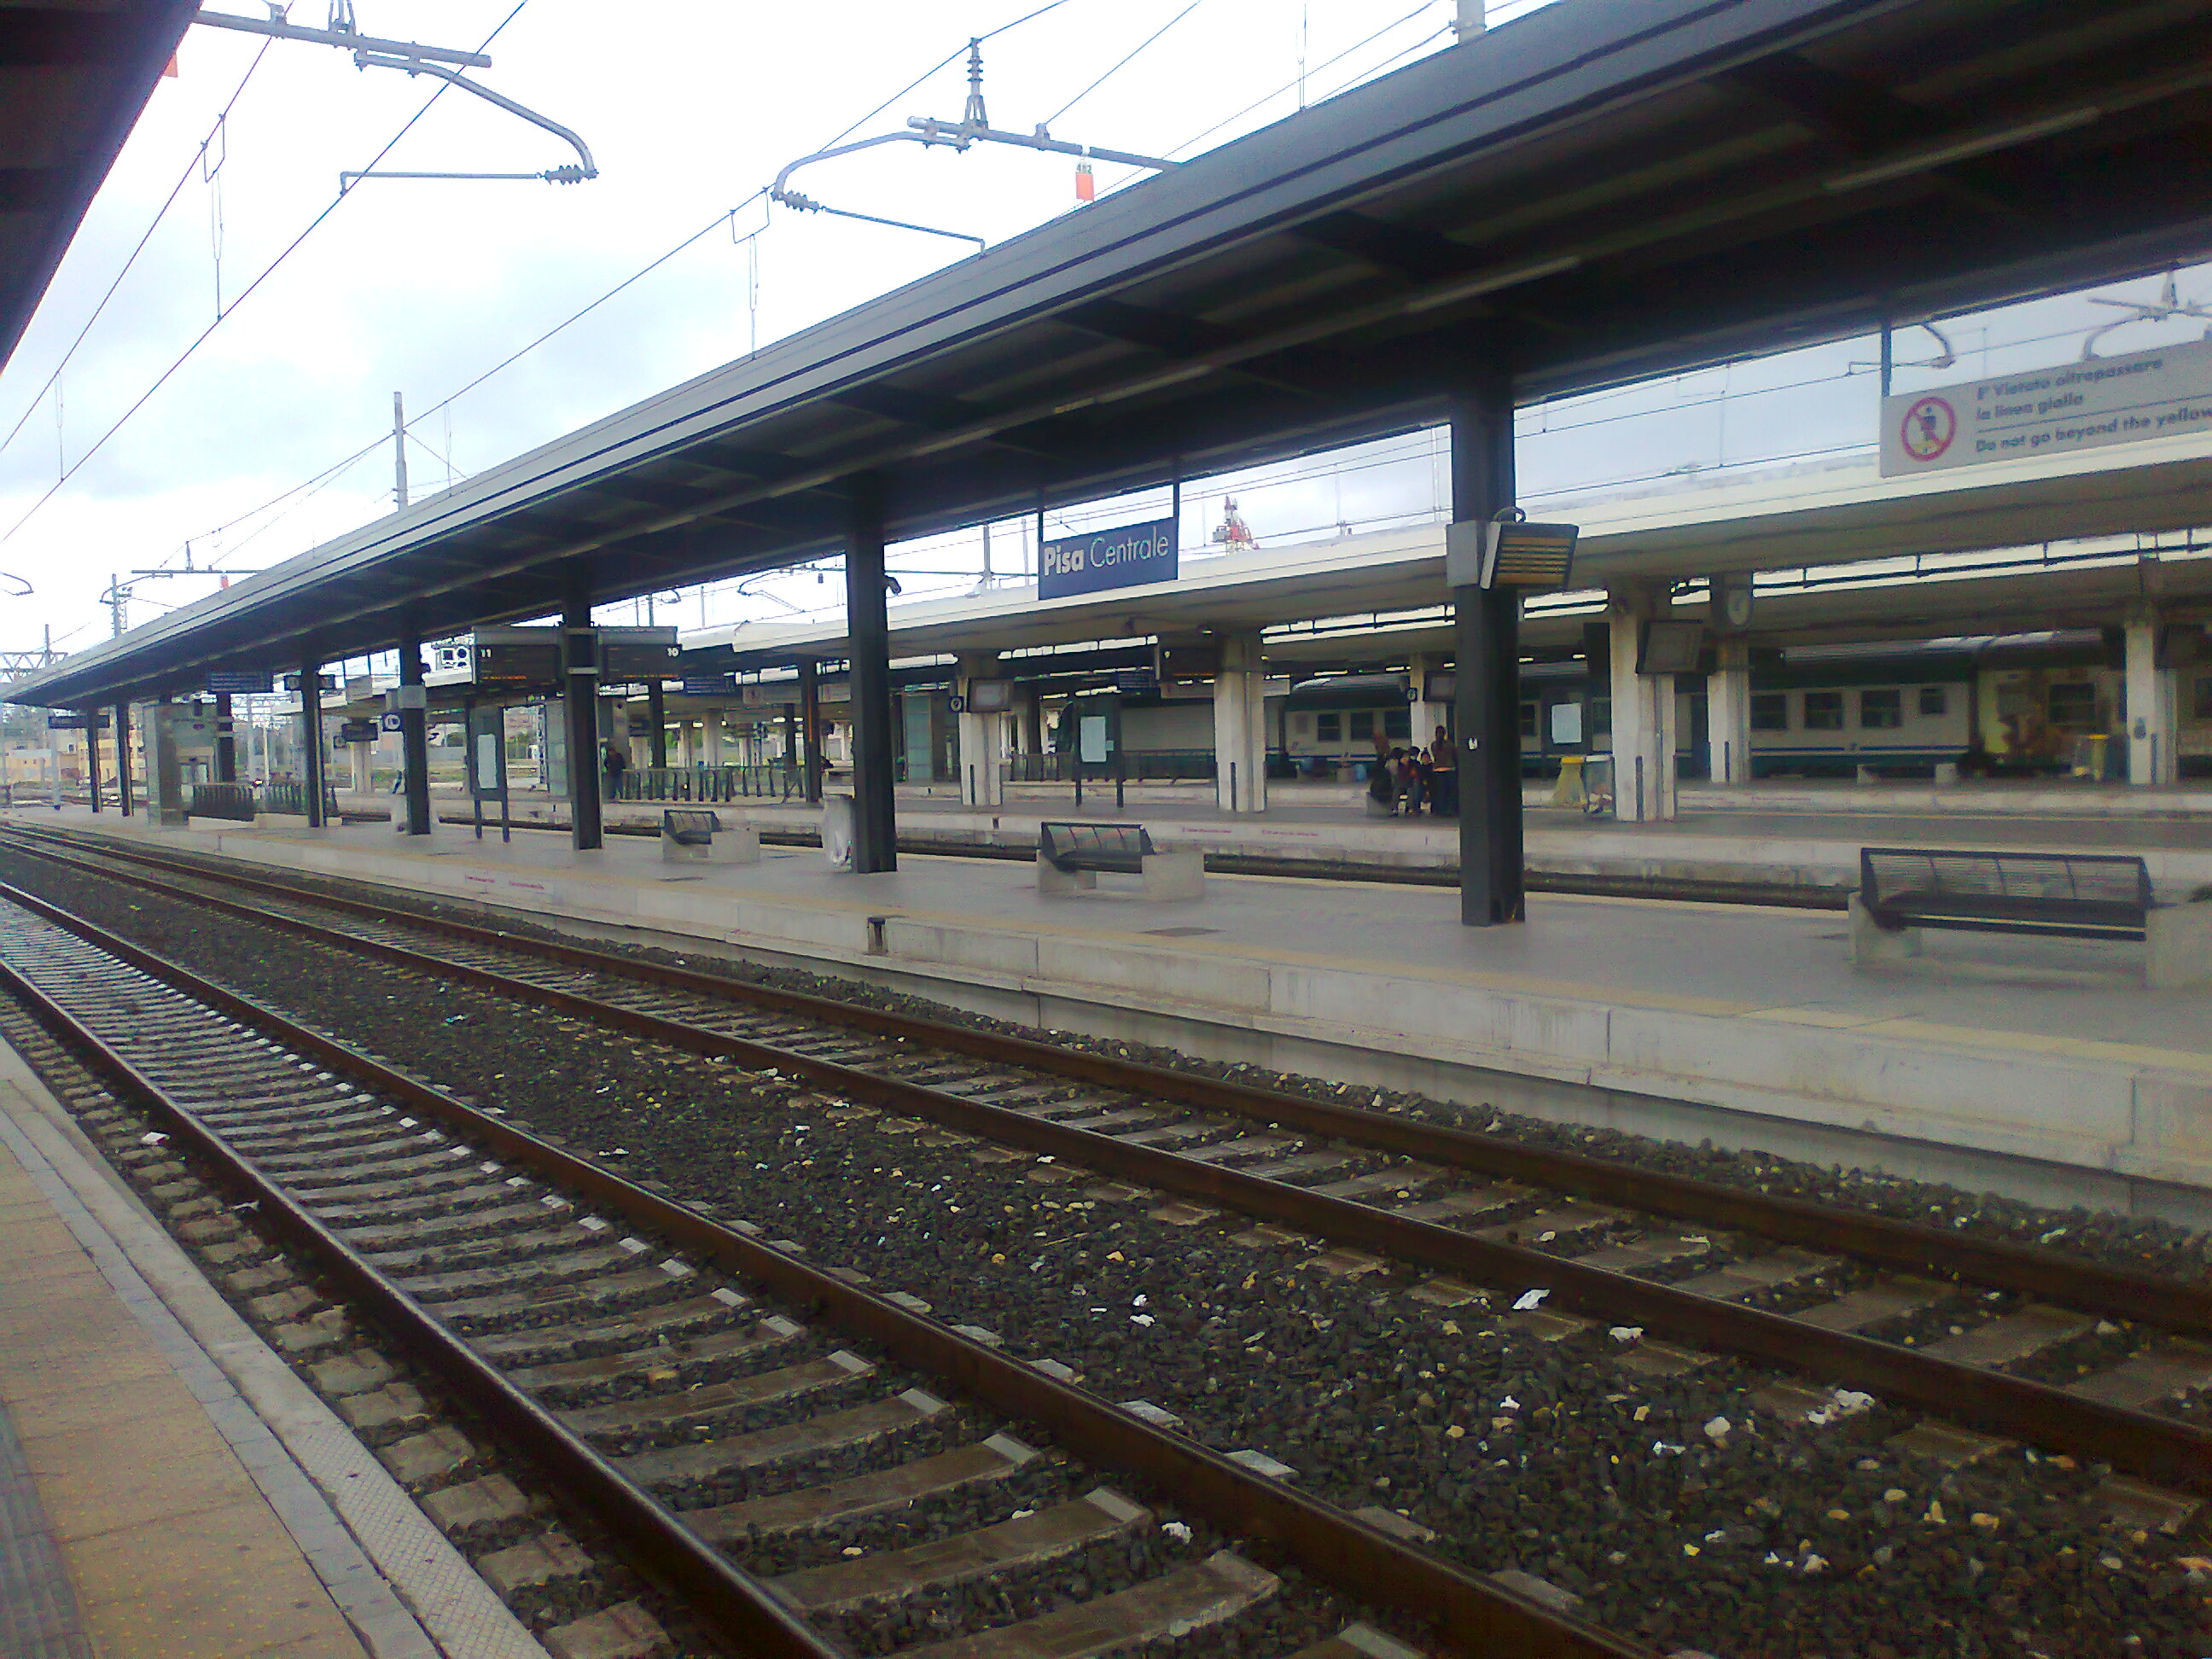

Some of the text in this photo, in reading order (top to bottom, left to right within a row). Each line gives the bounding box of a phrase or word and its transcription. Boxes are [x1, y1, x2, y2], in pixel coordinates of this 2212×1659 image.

[2031, 433, 2051, 448] go
[2054, 419, 2118, 442] beyond
[2123, 416, 2151, 431] the
[1044, 526, 1169, 576] Pisa Centrale
[480, 649, 492, 658] 11
